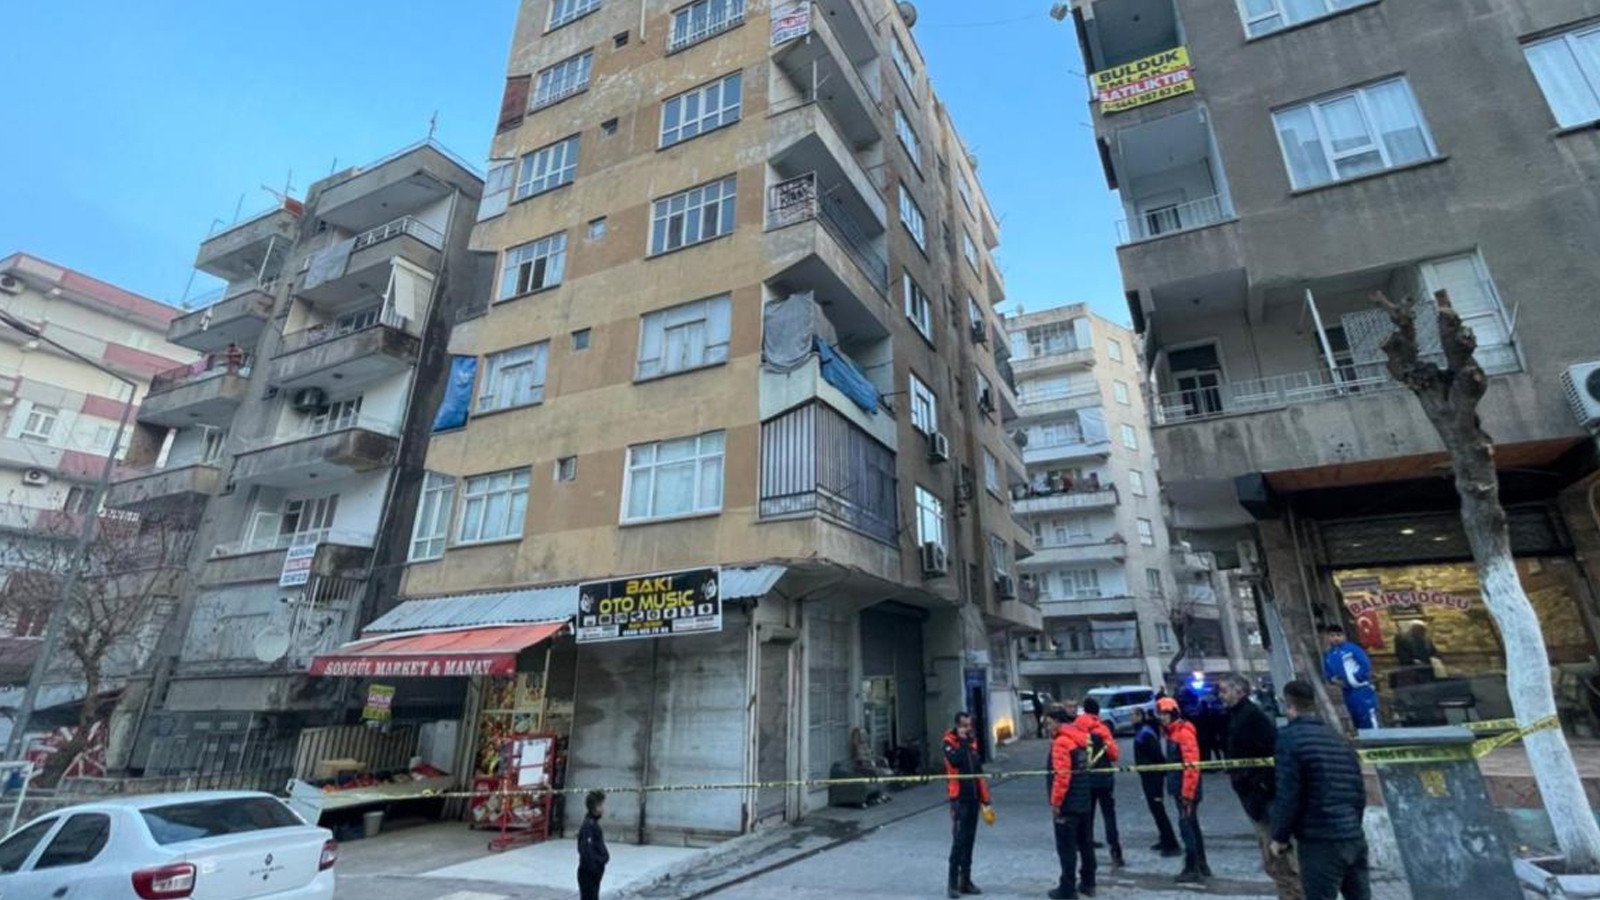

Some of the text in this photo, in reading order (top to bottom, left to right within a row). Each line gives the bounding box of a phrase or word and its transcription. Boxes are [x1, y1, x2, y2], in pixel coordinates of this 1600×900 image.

[1100, 50, 1179, 83] BULDUK
[599, 596, 635, 614] OTO
[323, 657, 493, 677] SONGÜL MARKET & MANAV
